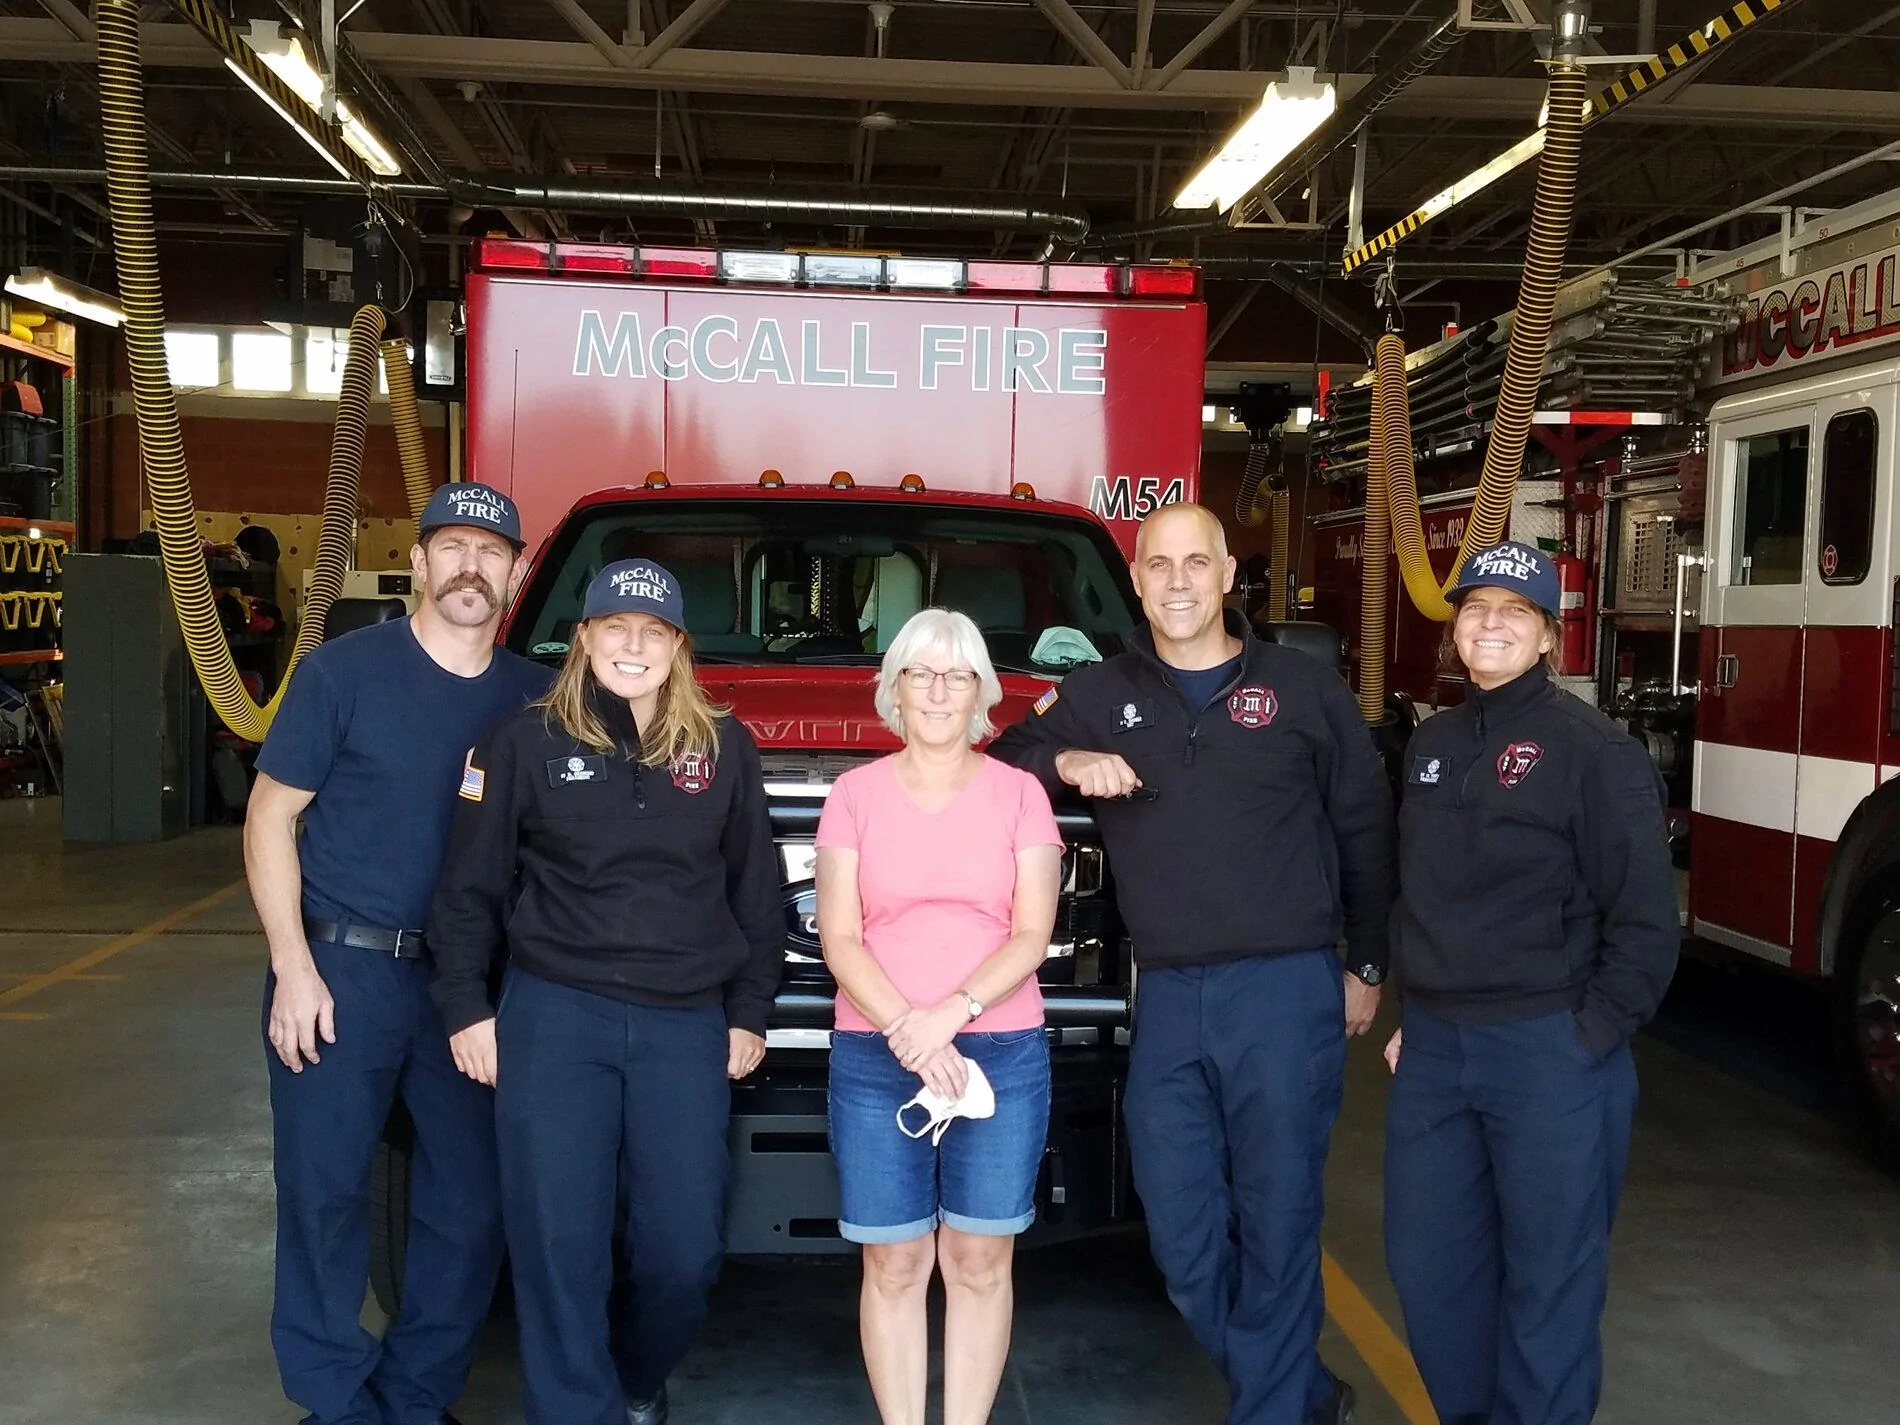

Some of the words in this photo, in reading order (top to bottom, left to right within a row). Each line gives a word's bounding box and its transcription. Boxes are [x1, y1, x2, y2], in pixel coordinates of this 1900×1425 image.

[1818, 228, 1829, 239] 50
[1735, 258, 1745, 268] 45
[573, 310, 897, 389] McCALL
[919, 325, 1107, 394] FIRE
[447, 488, 509, 516] McCALL
[455, 501, 501, 524] FIRE
[1089, 476, 1184, 521] M54
[1428, 522, 1446, 550] Since
[1472, 545, 1541, 575] McCALL
[1477, 560, 1530, 581] FIRE
[609, 567, 671, 595] McCALL
[618, 581, 664, 603] FIRE
